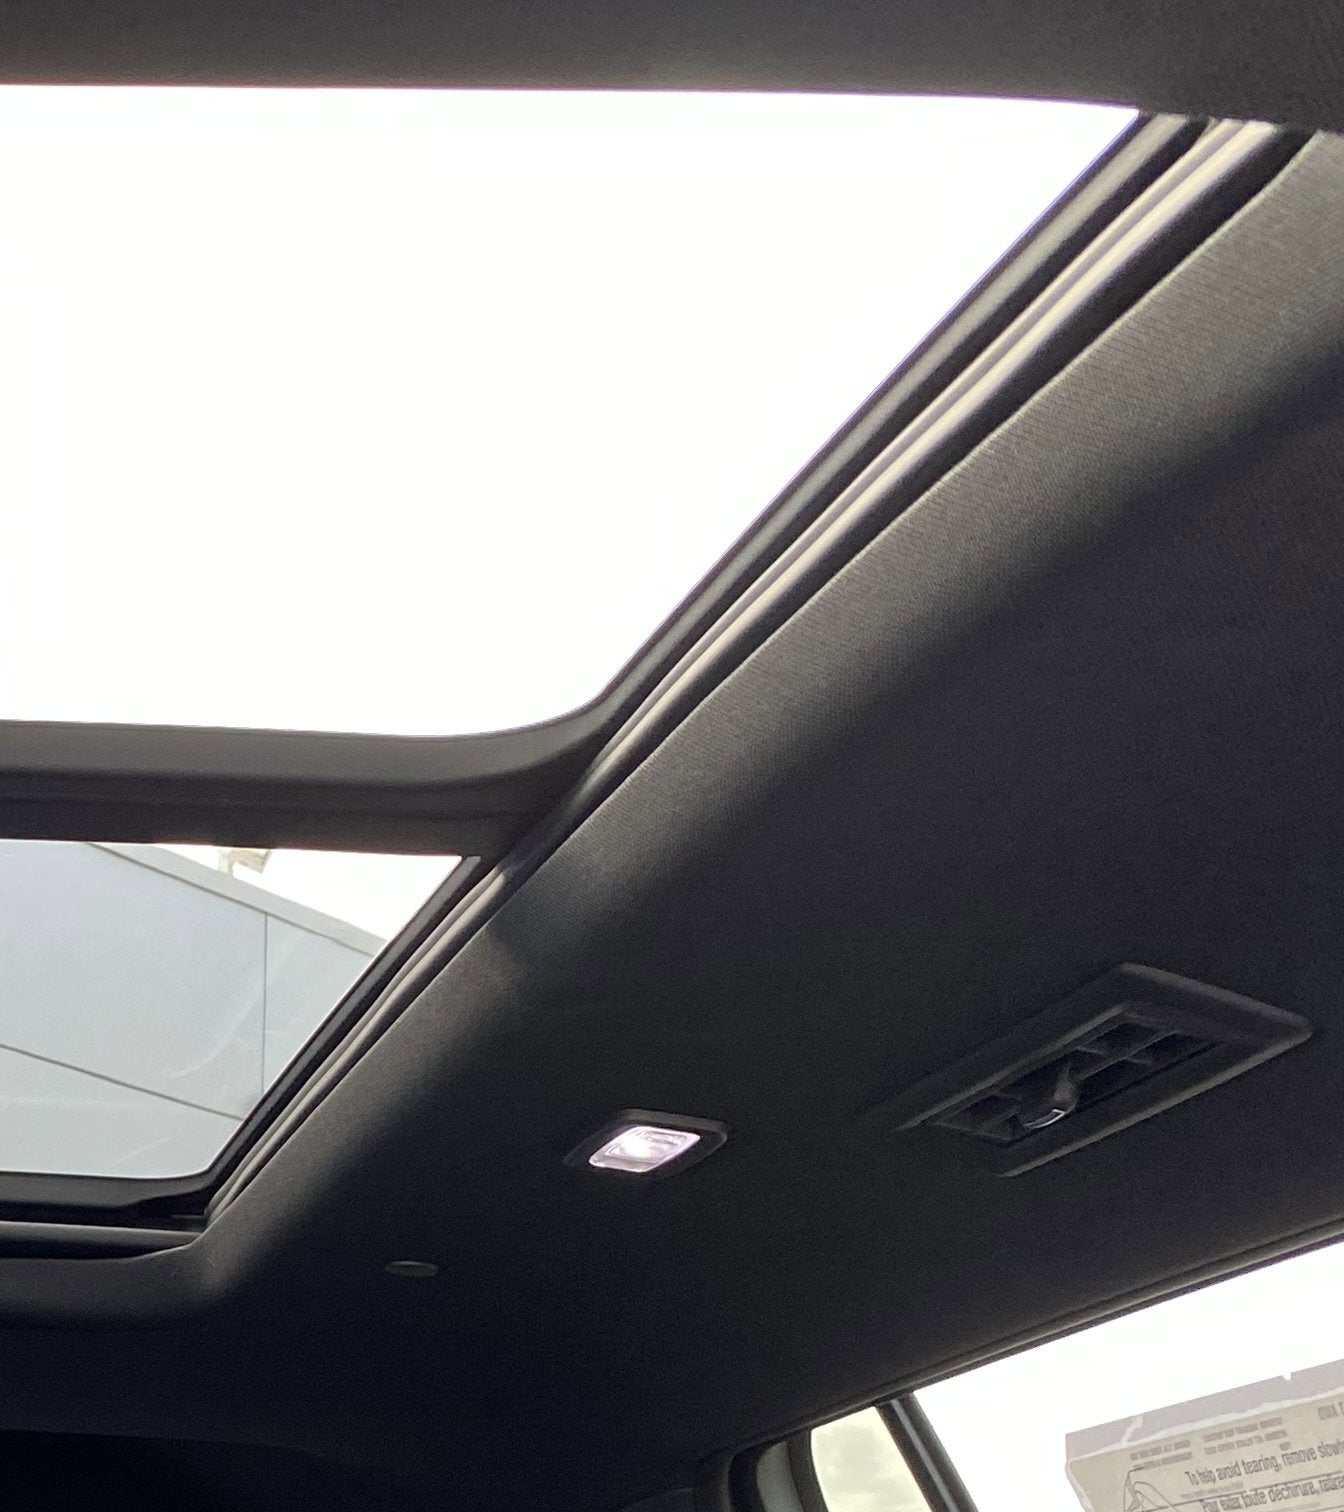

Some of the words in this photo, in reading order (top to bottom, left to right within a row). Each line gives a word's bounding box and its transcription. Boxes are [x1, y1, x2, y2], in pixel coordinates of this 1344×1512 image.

[1184, 1471, 1200, 1486] To
[1216, 1460, 1242, 1481] avoid
[1241, 1454, 1282, 1472] tearing,
[1281, 1447, 1317, 1466] remove
[1241, 1491, 1267, 1509] toute
